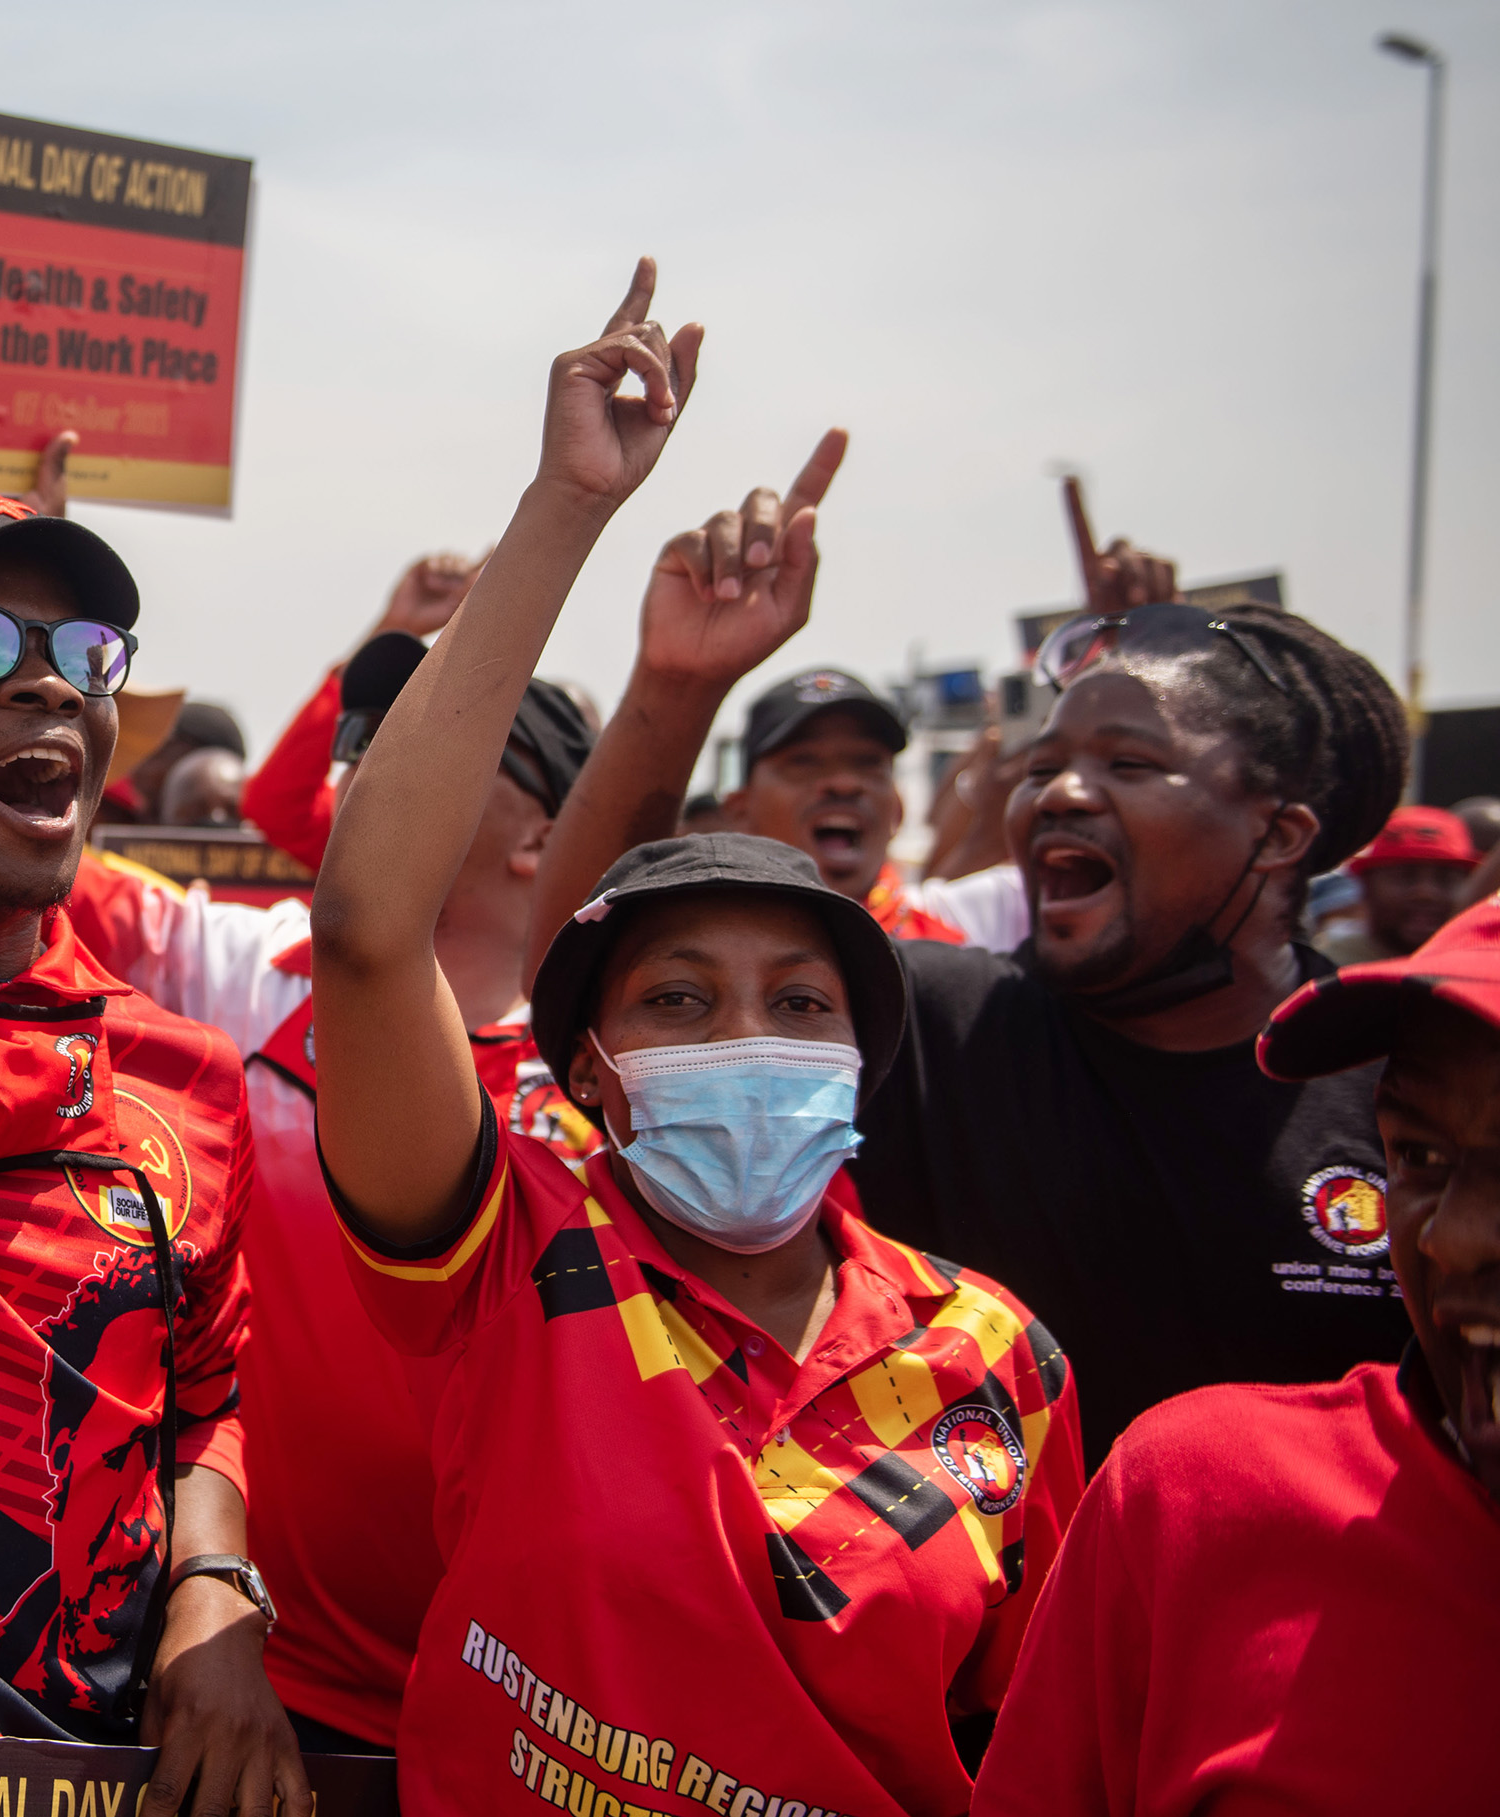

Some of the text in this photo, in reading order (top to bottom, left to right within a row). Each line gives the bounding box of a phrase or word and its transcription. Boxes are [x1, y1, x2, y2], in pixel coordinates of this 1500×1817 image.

[40, 144, 89, 197] DAY
[90, 153, 124, 203] OF
[122, 160, 207, 217] ACTION
[91, 277, 109, 313] &
[117, 274, 209, 329] Safety
[1, 323, 49, 367] the
[57, 328, 134, 376] Work
[141, 339, 218, 384] Place
[114, 1095, 145, 1115] EAGUE
[1300, 1165, 1364, 1197] NATIONAL
[115, 1206, 146, 1221] OUR LIFE
[116, 1197, 146, 1213] SOCIALI
[1309, 1225, 1346, 1254] MINE
[1272, 1260, 1320, 1275] union
[1328, 1263, 1370, 1279] mine
[1281, 1279, 1382, 1297] conference
[935, 1409, 1025, 1467] NATIONAL UNION
[942, 1455, 1021, 1512] OF MINE WORKERS
[460, 1618, 676, 1792] RUSTENBURG
[509, 1727, 677, 1817] STRUC
[50, 1779, 125, 1817] DAY
